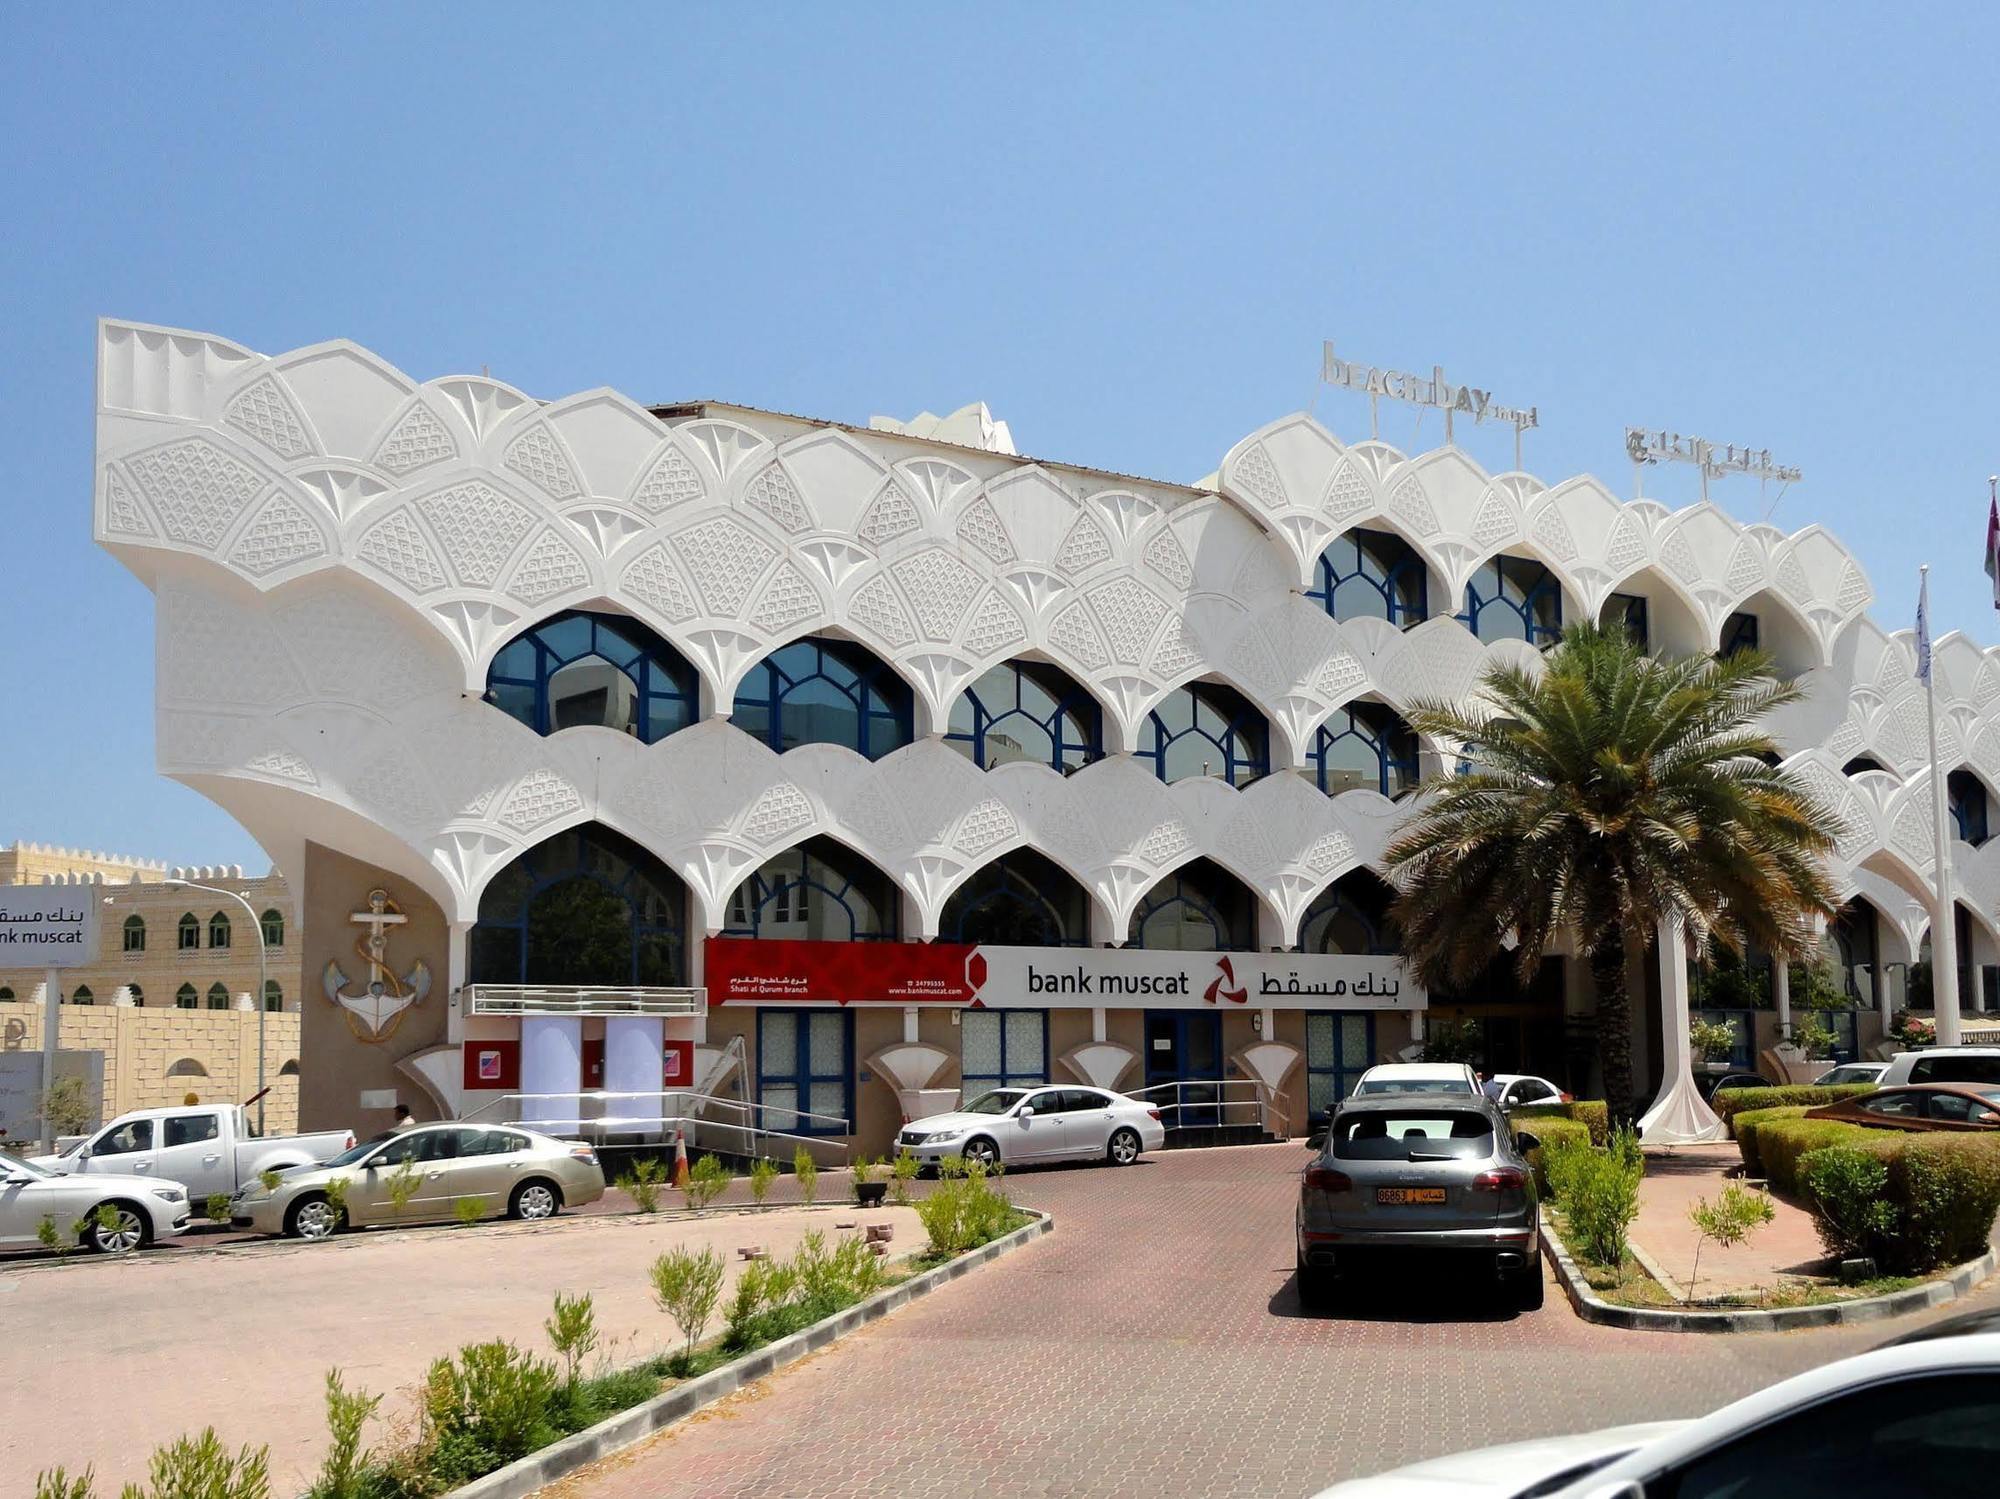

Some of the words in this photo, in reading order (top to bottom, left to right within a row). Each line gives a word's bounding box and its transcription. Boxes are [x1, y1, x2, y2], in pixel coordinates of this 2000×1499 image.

[0, 908, 43, 923] مسق
[47, 907, 84, 926] بنك
[22, 930, 82, 943] muscat
[730, 985, 749, 993] Shati
[759, 985, 783, 993] Qurum
[1028, 965, 1092, 994] bank
[1099, 971, 1189, 995] muscat
[1259, 971, 1346, 997] مسقط
[1350, 971, 1400, 1004] بنك
